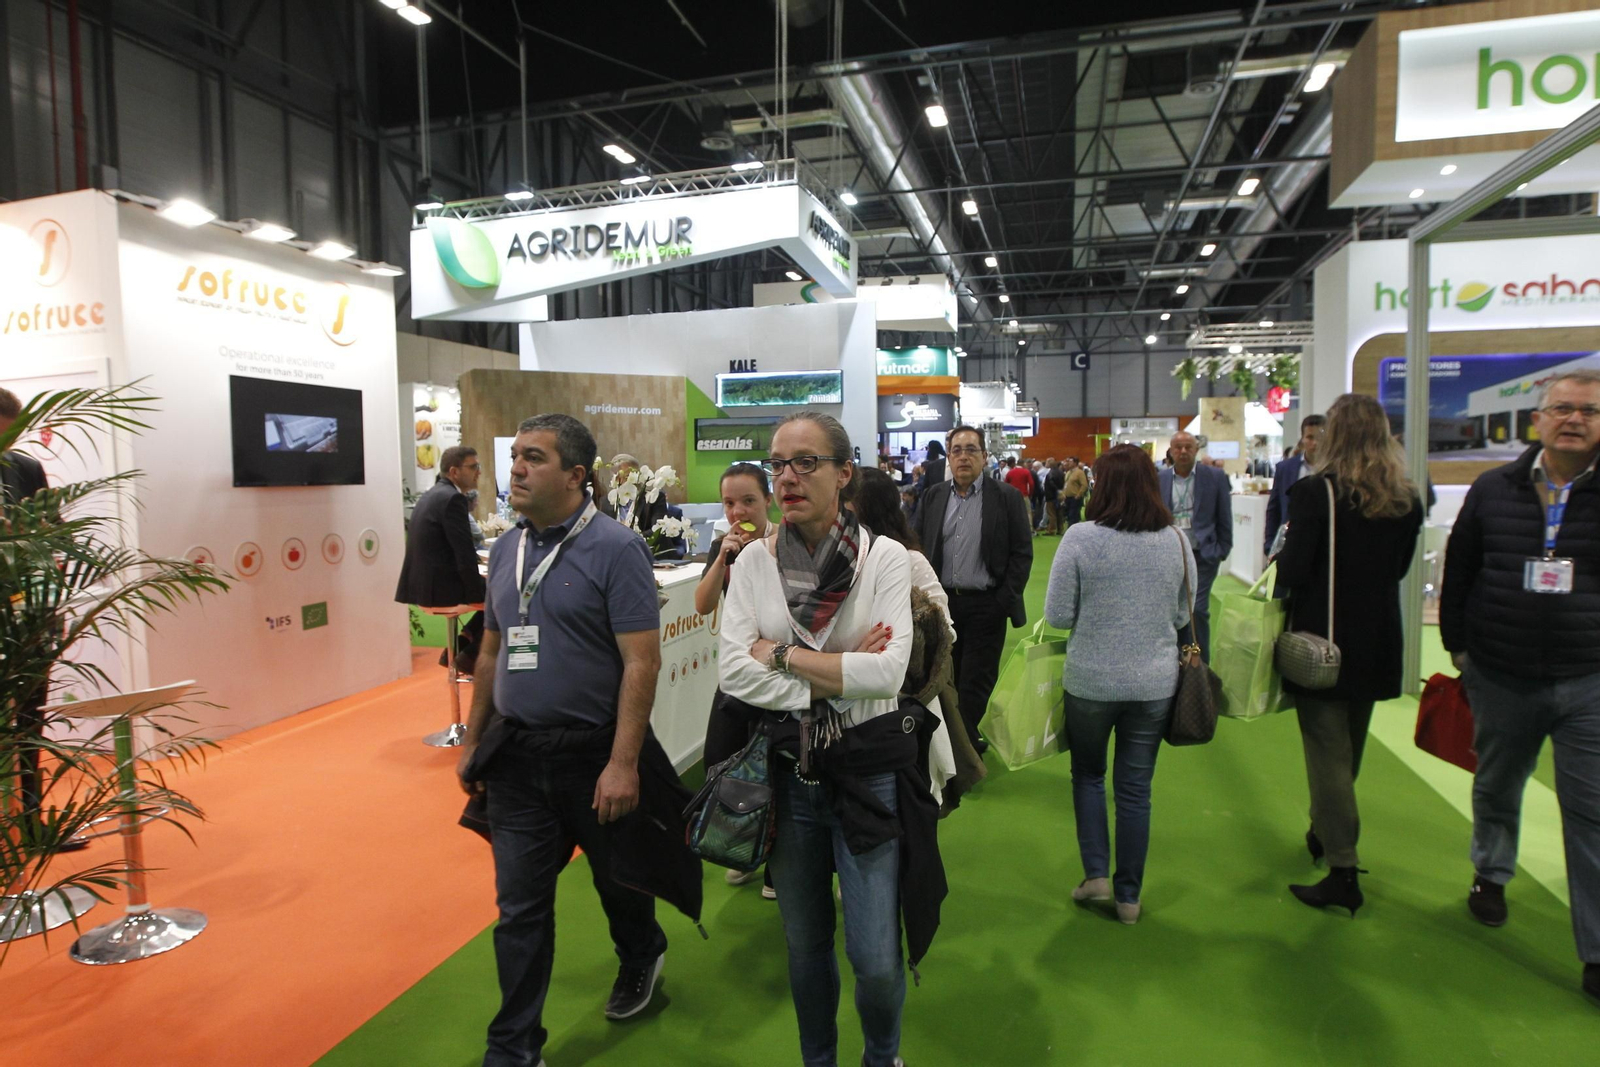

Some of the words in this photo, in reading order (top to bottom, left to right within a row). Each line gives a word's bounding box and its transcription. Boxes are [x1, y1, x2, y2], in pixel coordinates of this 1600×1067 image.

[1477, 47, 1600, 110] ho
[507, 216, 692, 259] AGRIDEMUR
[218, 345, 283, 364] Operational
[286, 357, 336, 370] excellence
[1074, 353, 1087, 369] C
[236, 362, 247, 372] for
[250, 366, 272, 375] more
[274, 367, 292, 377] than
[305, 371, 324, 381] years
[729, 359, 757, 373] KALE
[877, 362, 931, 375] rutmac
[584, 403, 662, 415] agridemur.com
[697, 437, 753, 451] escarolas
[275, 615, 292, 627] IFS
